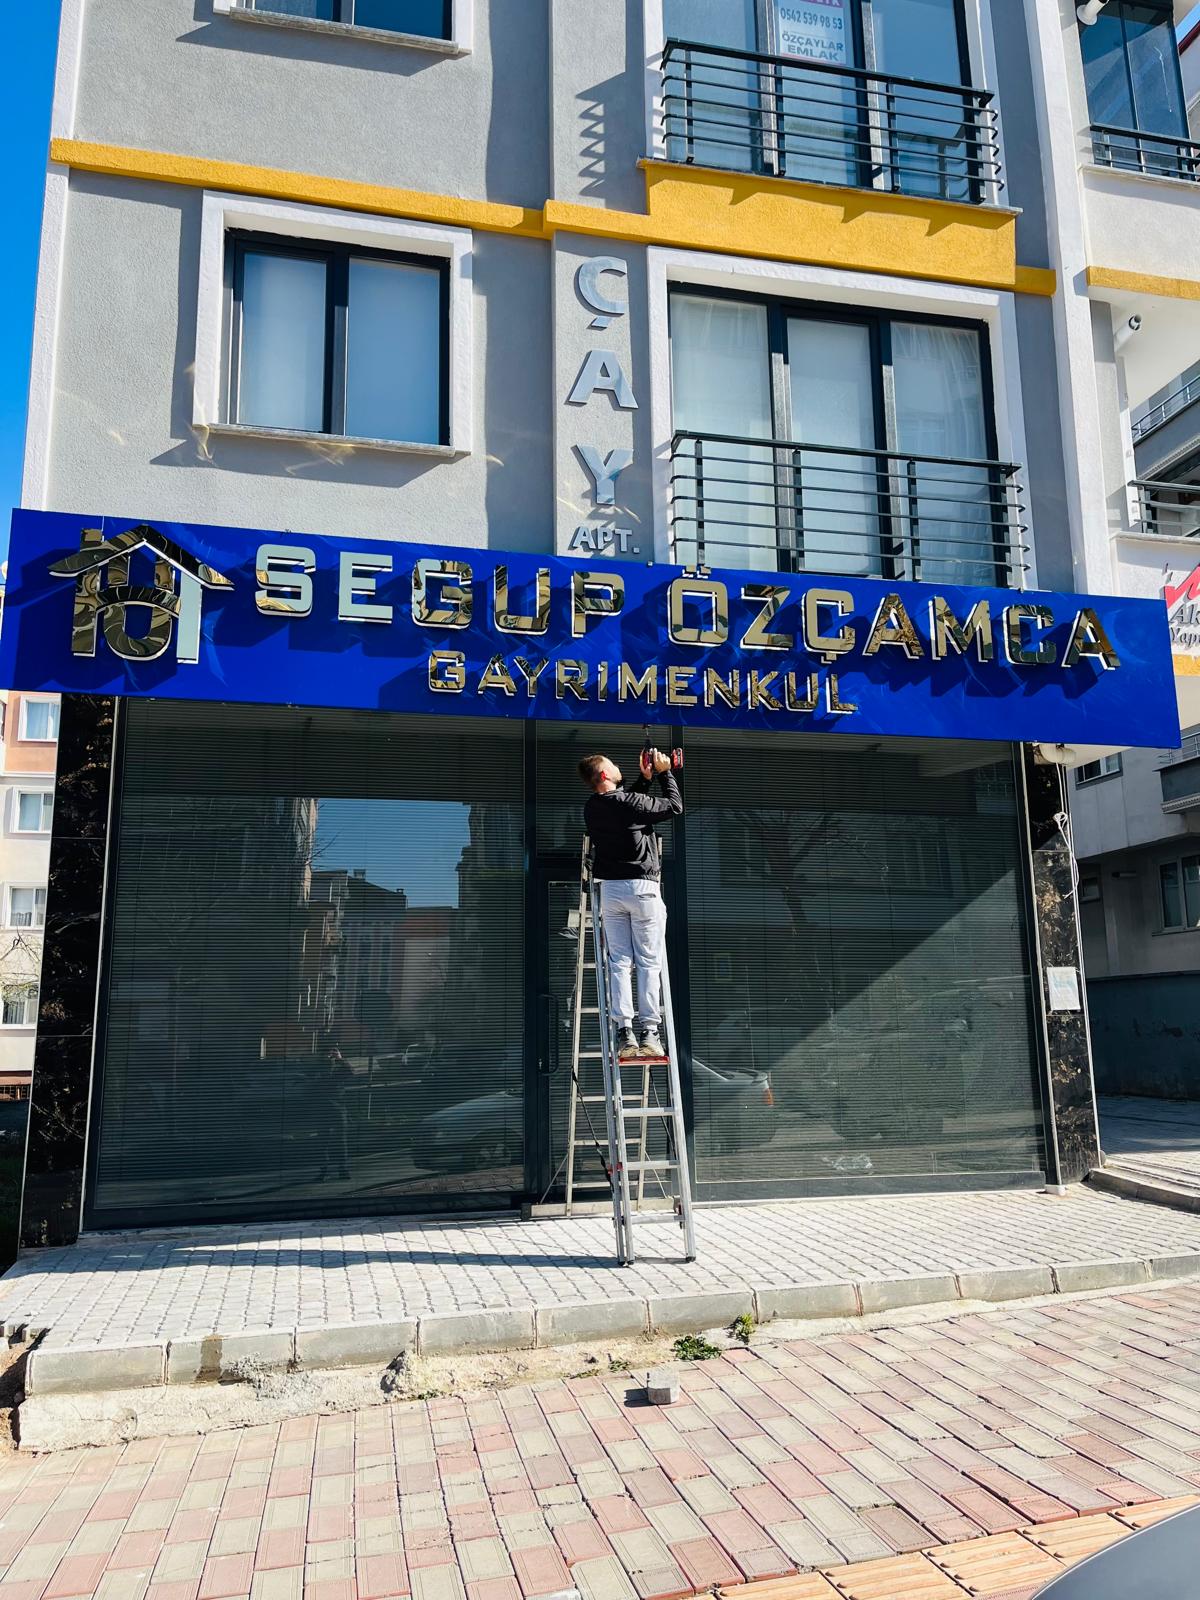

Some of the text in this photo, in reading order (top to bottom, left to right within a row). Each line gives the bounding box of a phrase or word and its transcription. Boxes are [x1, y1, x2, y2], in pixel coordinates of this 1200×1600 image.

[780, 8, 843, 30] 0542 539 98 53
[782, 31, 844, 52] ÖZÇAYLAR
[788, 44, 839, 61] EMLAK
[566, 255, 640, 505] ÇAY
[571, 526, 641, 554] APT.
[667, 565, 1121, 671] ÖZÇAMCA
